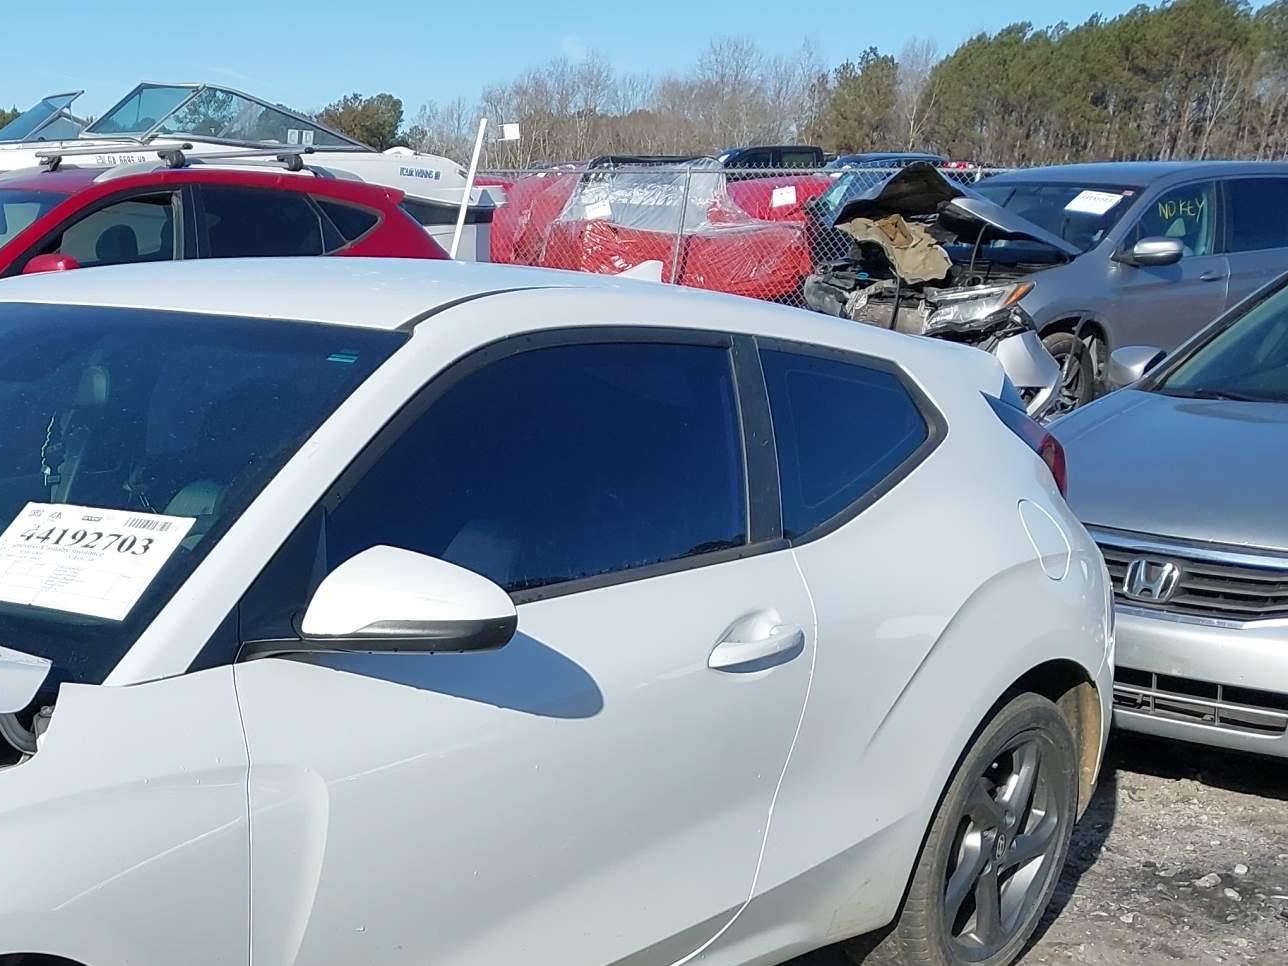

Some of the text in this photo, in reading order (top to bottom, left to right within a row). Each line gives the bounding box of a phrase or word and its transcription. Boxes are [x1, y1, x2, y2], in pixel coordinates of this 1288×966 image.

[1158, 196, 1205, 223] NO KEY
[19, 525, 155, 557] 44192703
